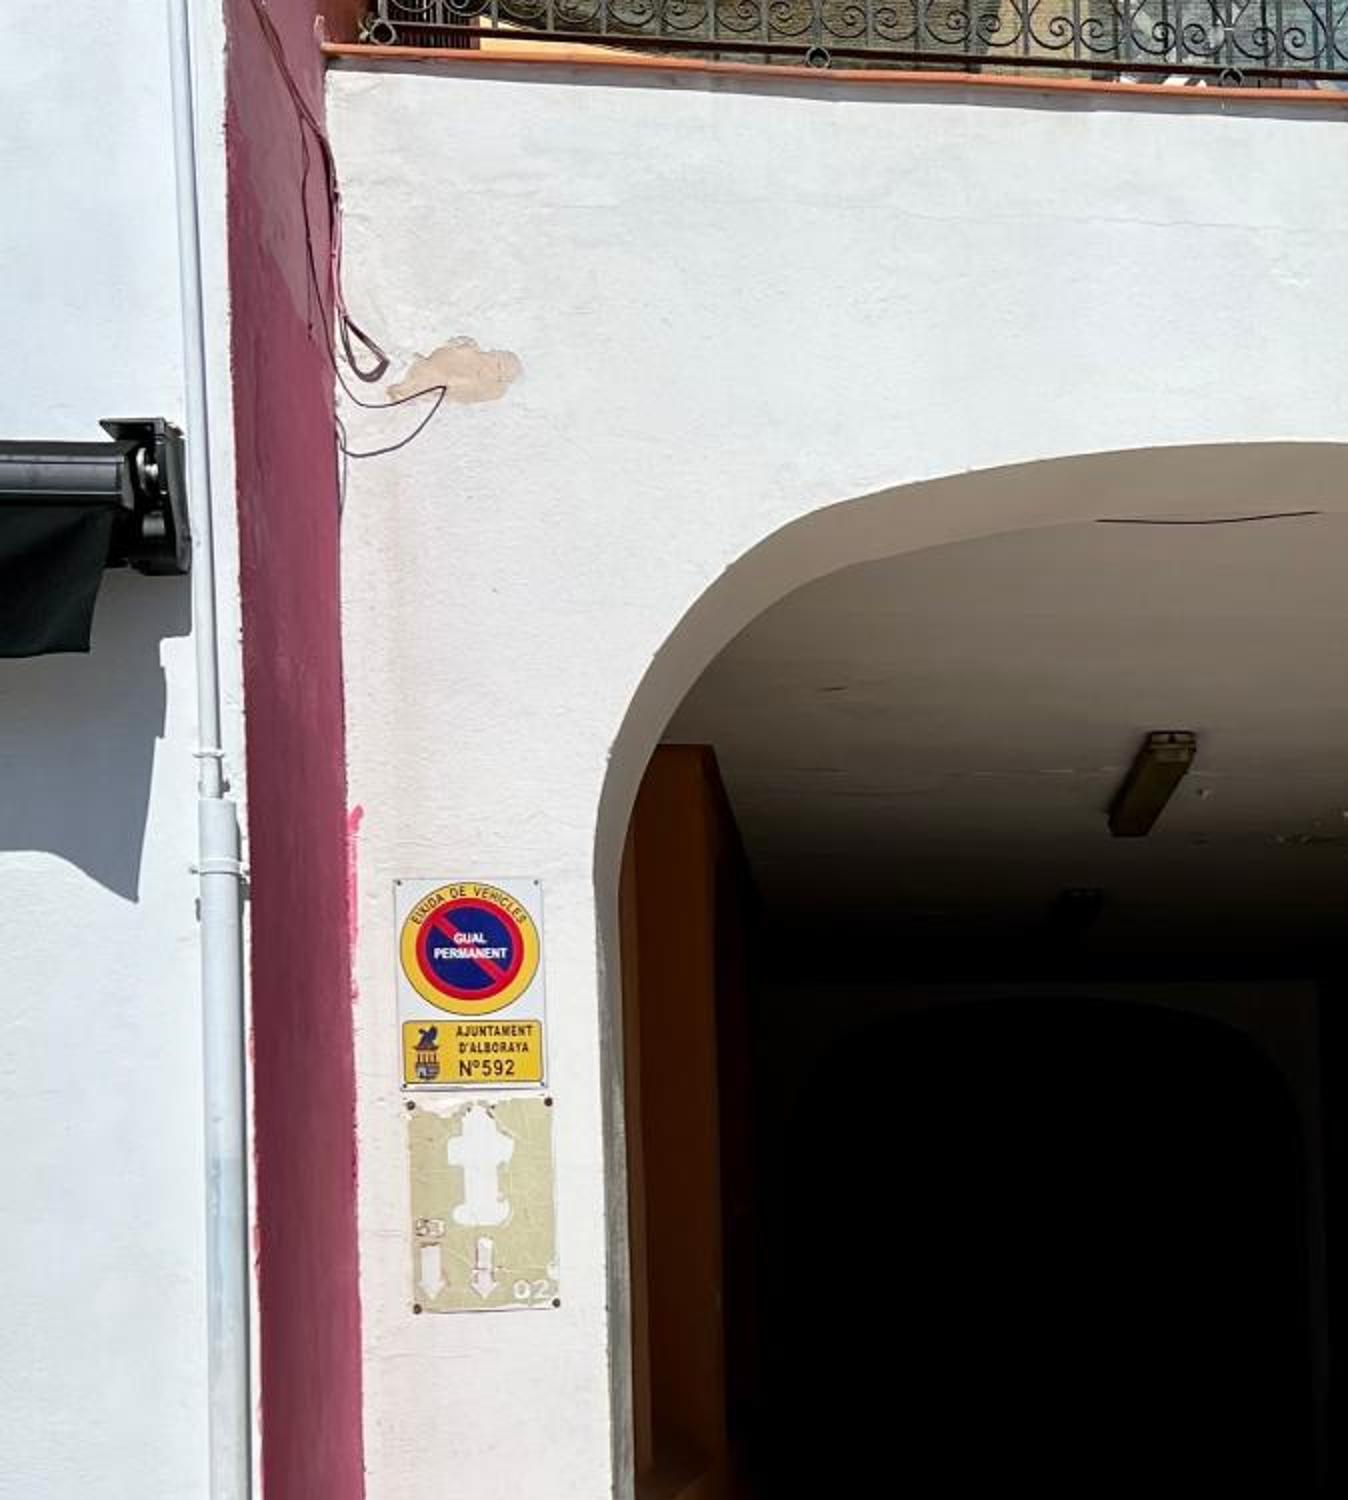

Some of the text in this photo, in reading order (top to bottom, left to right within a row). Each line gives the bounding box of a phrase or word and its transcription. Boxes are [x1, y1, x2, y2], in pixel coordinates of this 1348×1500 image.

[411, 886, 527, 925] EIXIDA DE VEHICLES
[454, 932, 487, 943] GUAL
[434, 947, 508, 959] PERMANENT
[456, 1025, 533, 1037] AJUNTAMENT
[459, 1042, 529, 1054] D'ALBORAYA
